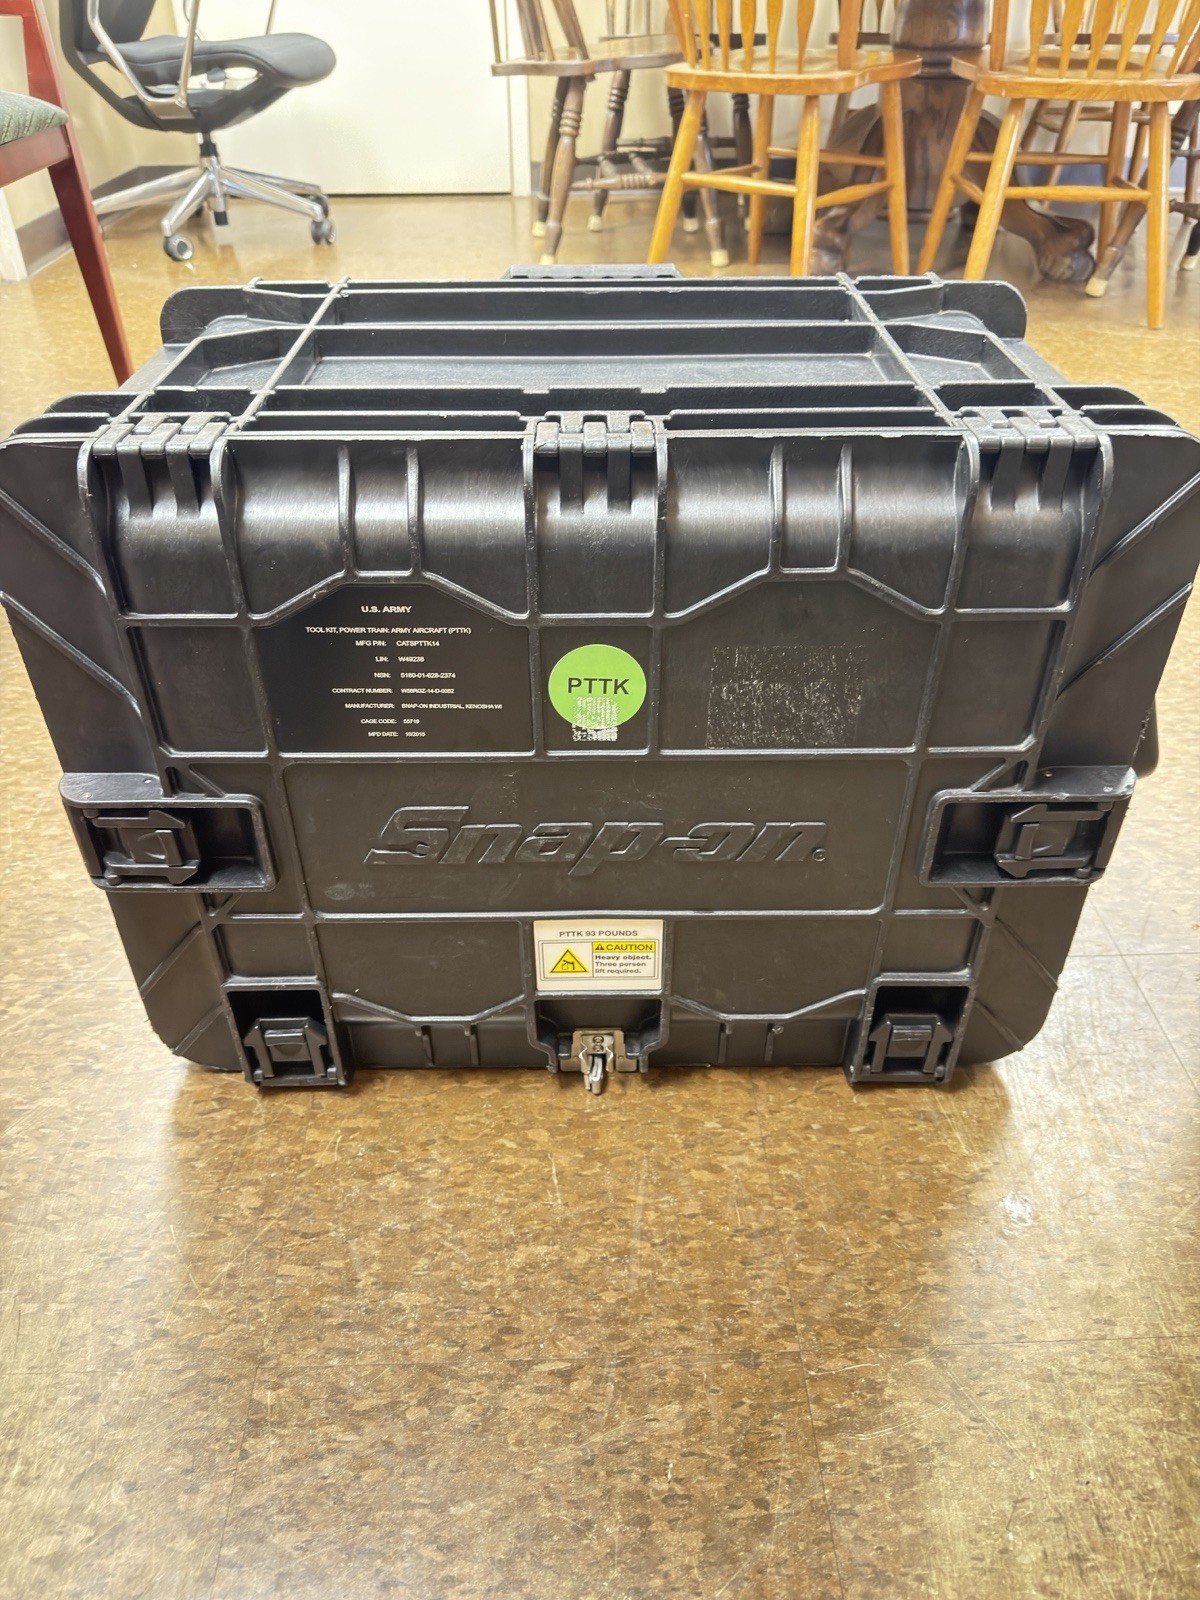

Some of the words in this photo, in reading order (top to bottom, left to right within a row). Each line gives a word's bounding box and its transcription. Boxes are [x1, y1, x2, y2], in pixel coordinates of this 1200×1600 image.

[360, 605, 381, 614] U.S.
[382, 605, 413, 614] ARMY
[304, 626, 325, 634] TOOL
[339, 626, 366, 634] POWER
[390, 627, 412, 635] ARMY
[412, 627, 448, 635] AIRCRAFT
[448, 627, 472, 636] (PTTK)
[355, 639, 373, 647] MFG
[375, 655, 390, 663] LIN:
[374, 671, 392, 679] NSN:
[567, 677, 630, 695] PTTK
[344, 702, 396, 710] MANUFACTURER:
[605, 943, 653, 951] CAUTION
